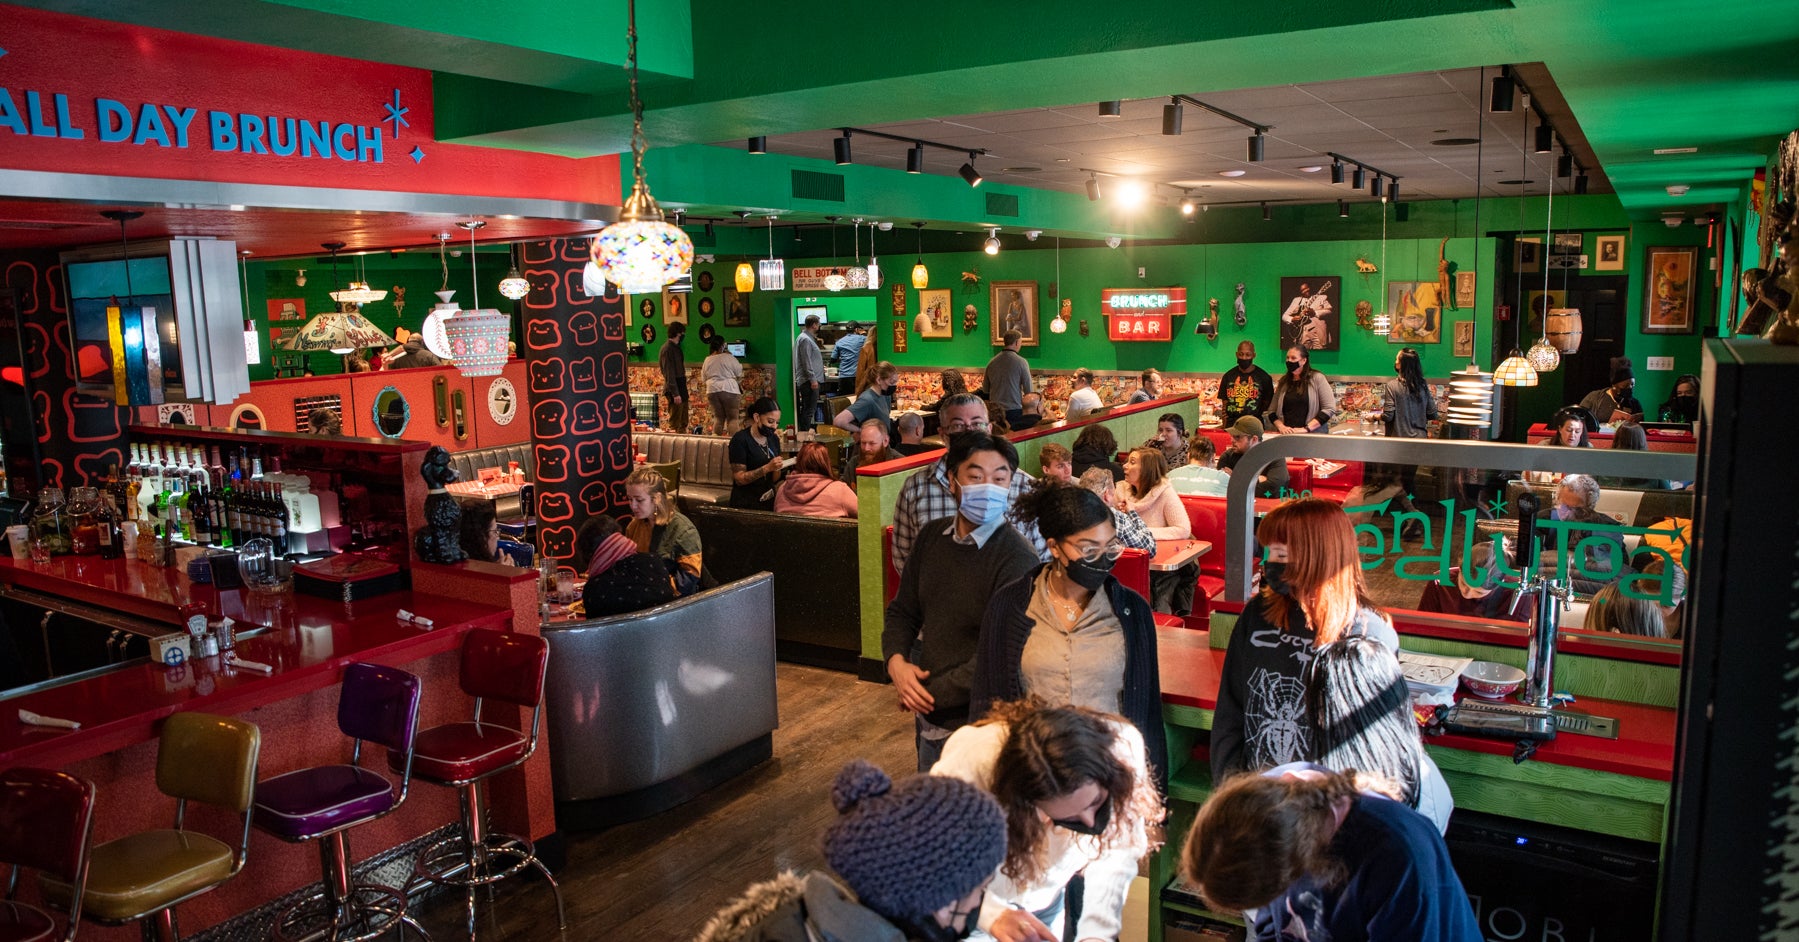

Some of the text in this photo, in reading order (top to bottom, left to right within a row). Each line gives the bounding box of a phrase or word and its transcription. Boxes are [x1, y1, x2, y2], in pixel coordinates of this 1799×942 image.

[0, 88, 384, 163] ALL DAY BRUNCH
[793, 268, 848, 278] BELL BOTTM
[1110, 295, 1168, 308] BRUNCH
[1133, 310, 1145, 318] and
[1118, 320, 1160, 334] BAR
[1226, 387, 1259, 399] BLESSED
[1536, 518, 1692, 607] Toa
